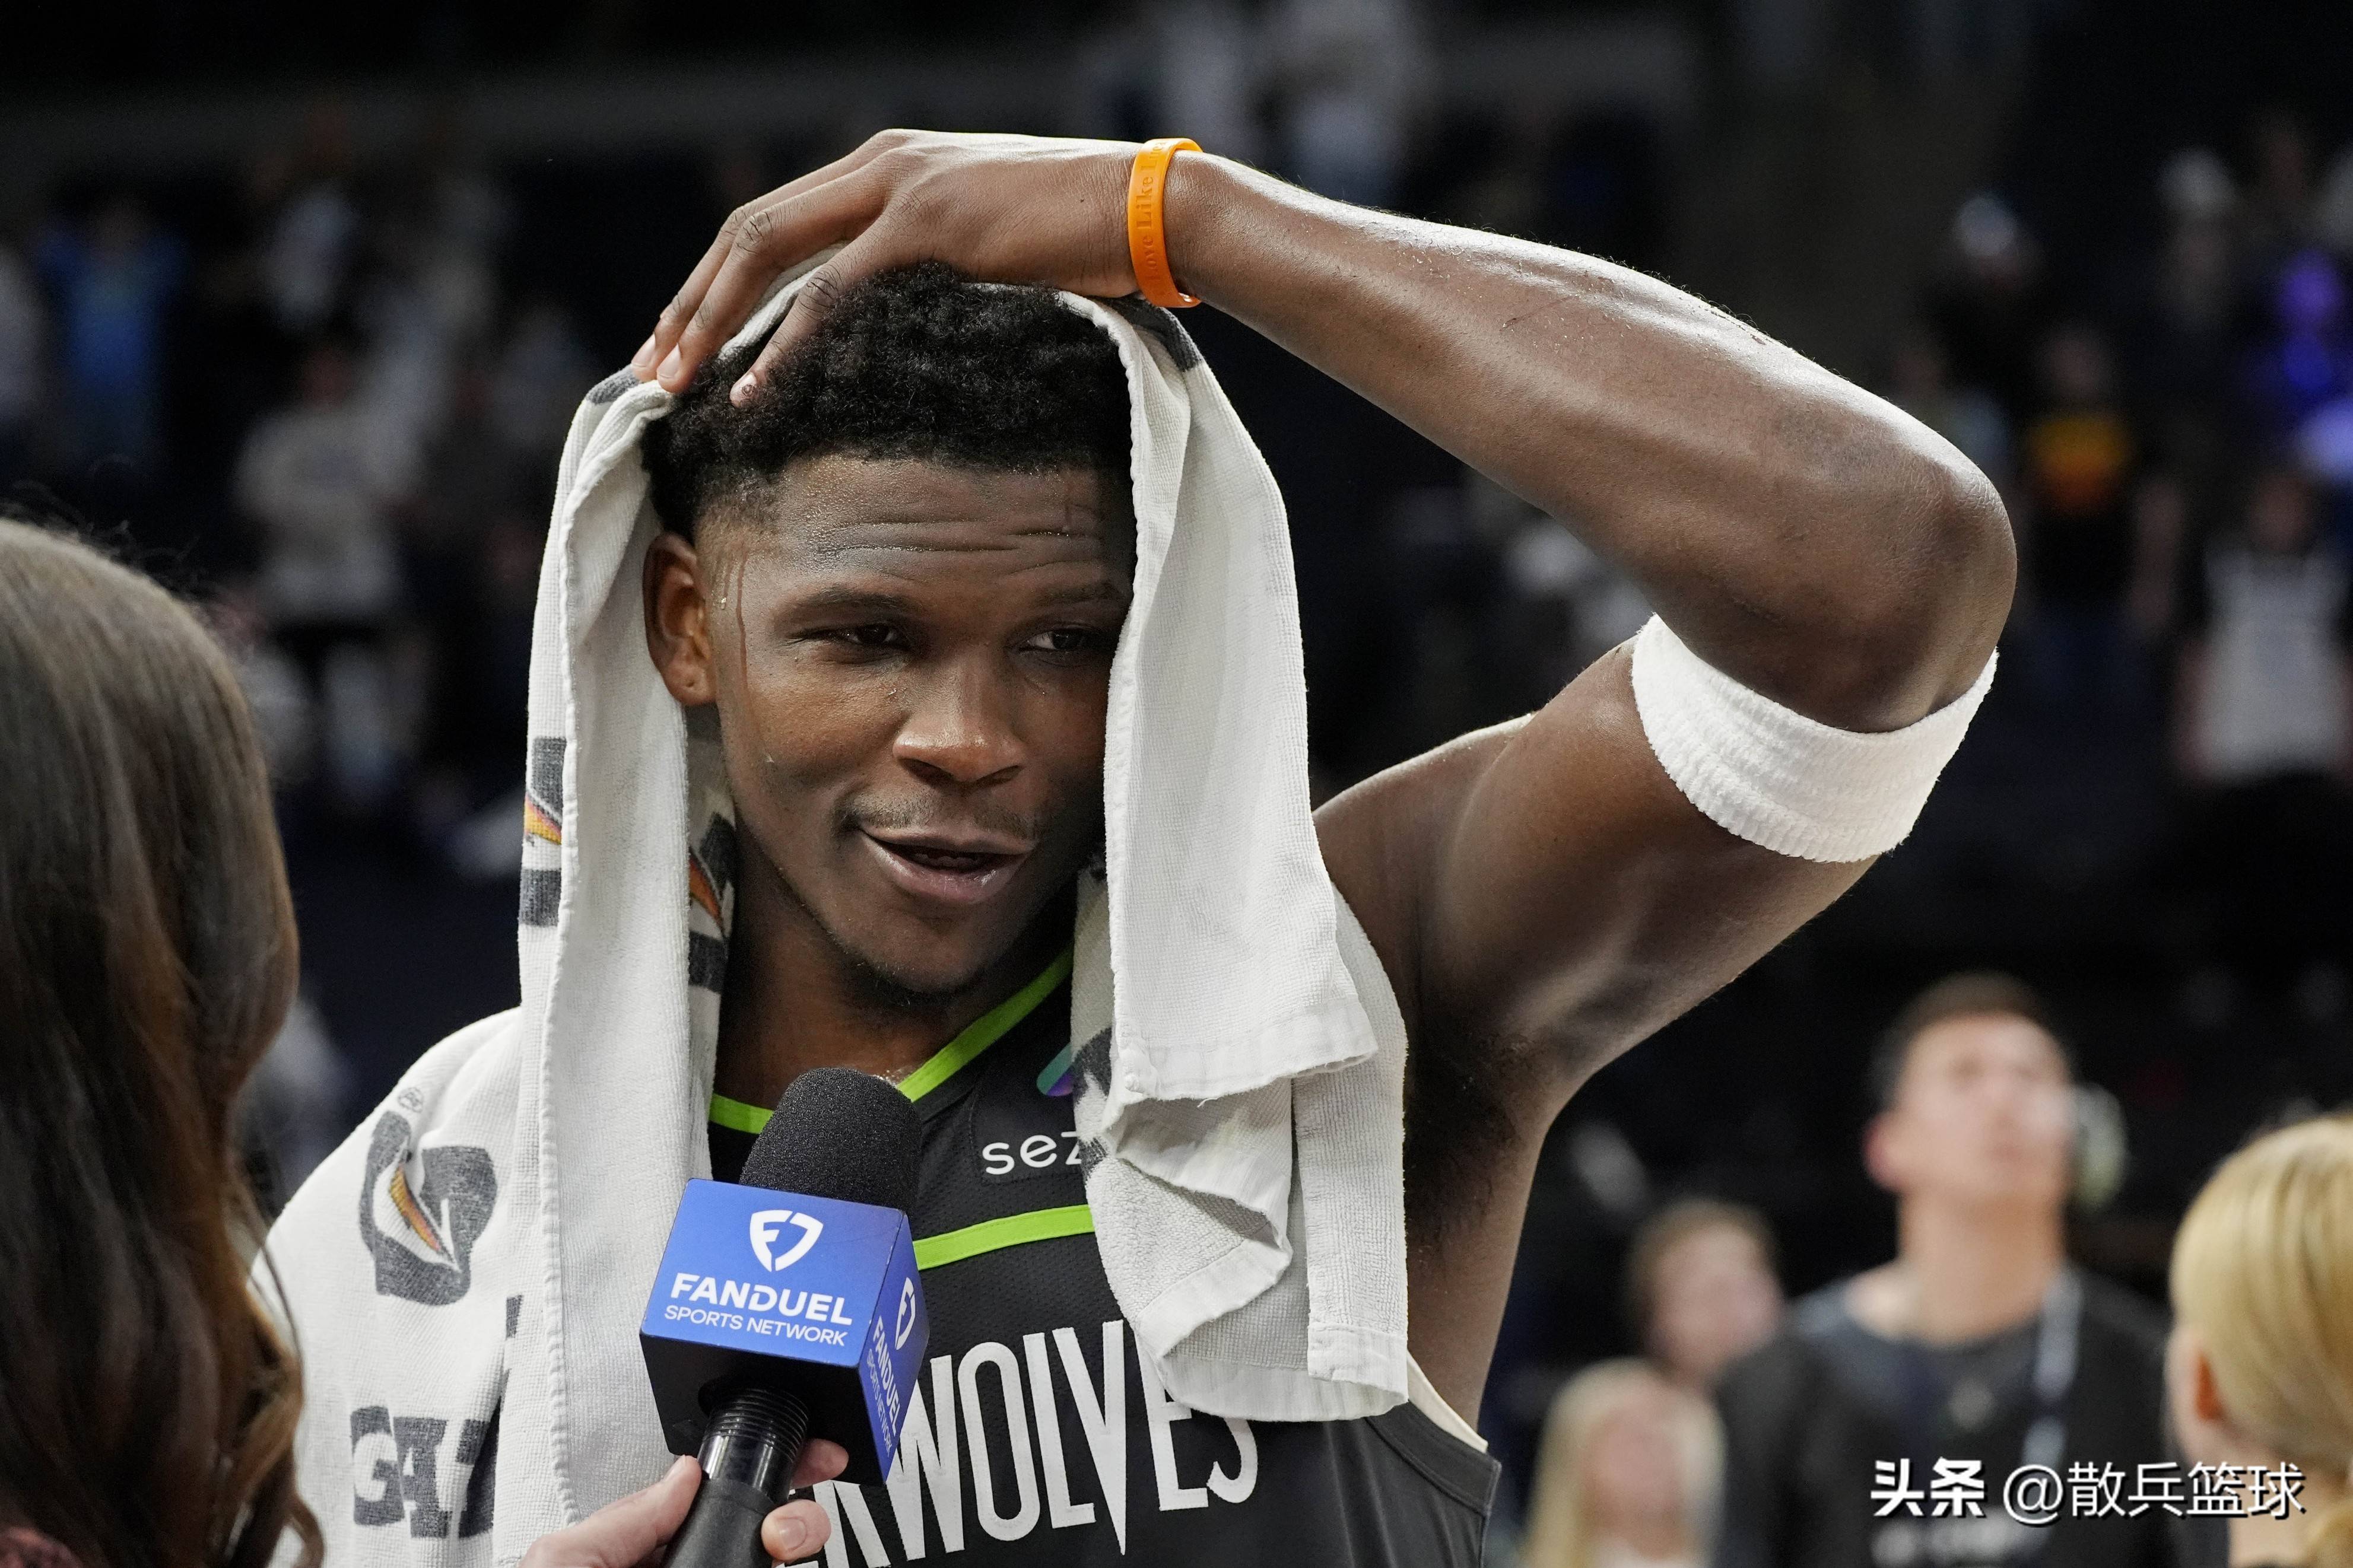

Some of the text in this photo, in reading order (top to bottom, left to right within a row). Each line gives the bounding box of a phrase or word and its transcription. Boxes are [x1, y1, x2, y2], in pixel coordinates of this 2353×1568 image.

[1136, 176, 1153, 230] Like
[664, 1305, 848, 1347] SPORTS NETWORK
[671, 1273, 853, 1325] FANDUEL
[873, 1315, 900, 1436] FANDUEL
[877, 1398, 893, 1458] NETWORK
